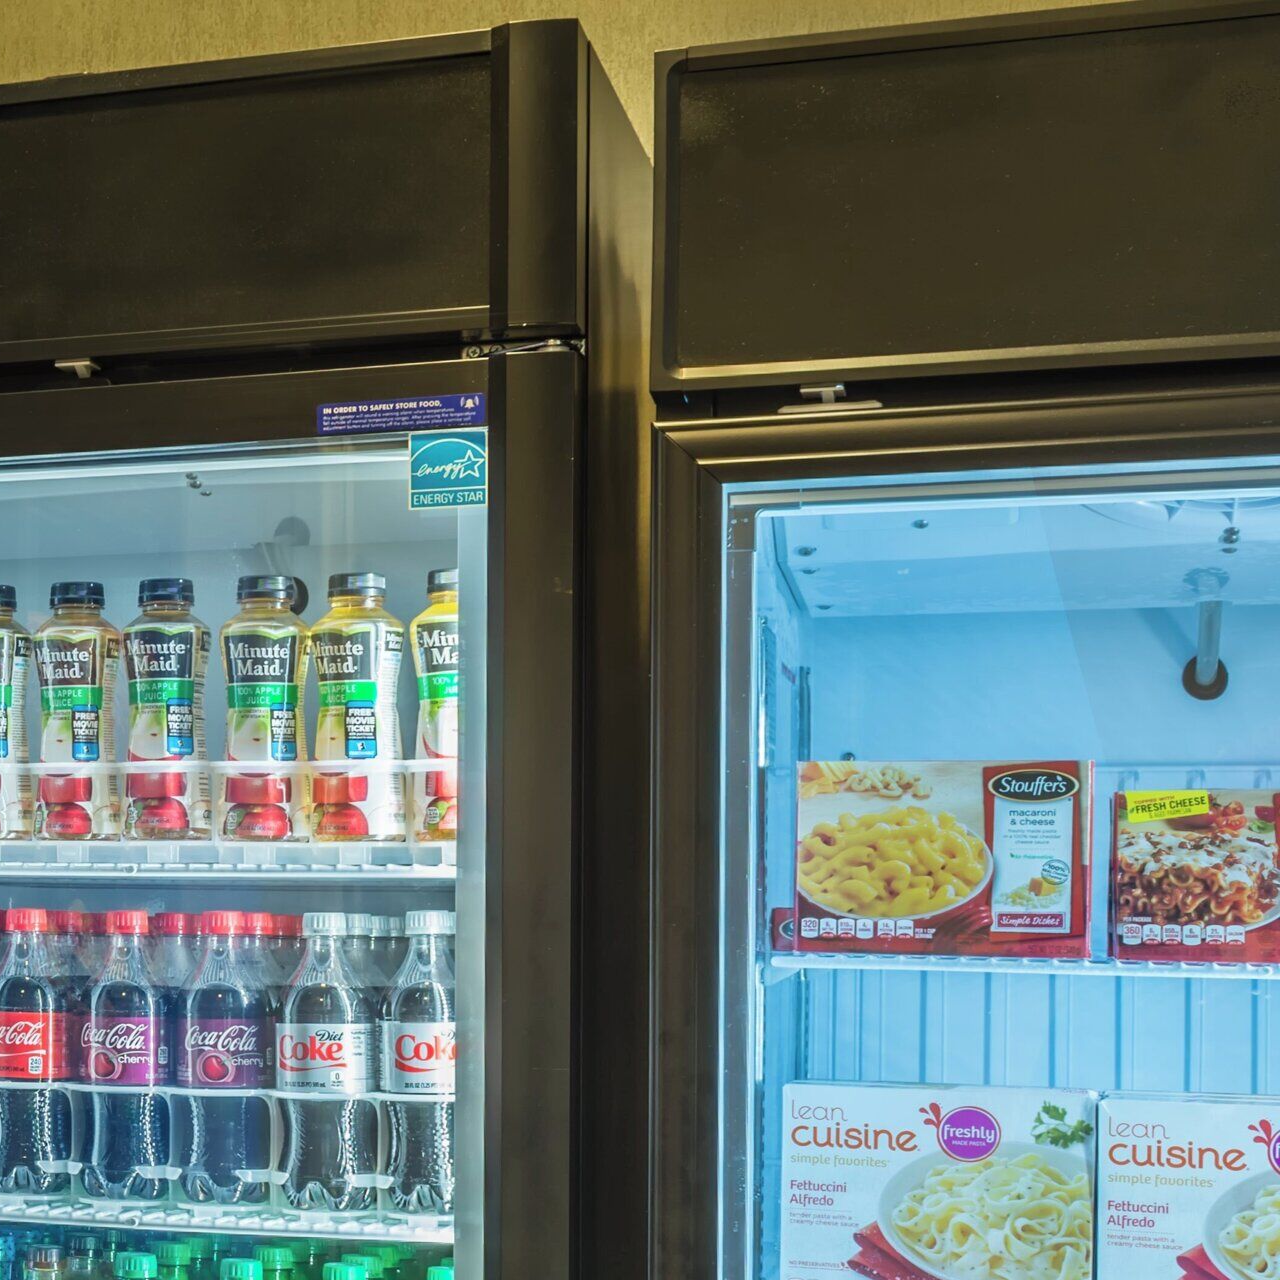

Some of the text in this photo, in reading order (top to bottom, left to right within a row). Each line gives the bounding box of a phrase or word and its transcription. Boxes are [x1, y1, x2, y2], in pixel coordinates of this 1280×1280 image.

[333, 406, 357, 414] ORDER
[370, 403, 394, 412] SAFELY
[395, 401, 417, 410] STORE
[413, 492, 483, 505] ENERGY STAR
[229, 642, 289, 659] Minute
[135, 655, 178, 672] Maid
[237, 659, 281, 676] Maid
[152, 682, 179, 691] APPLE
[258, 685, 282, 695] APPLE
[245, 695, 270, 704] JUICE
[349, 708, 372, 717] FREE
[346, 716, 375, 725] MOVIE
[346, 724, 375, 733] TICKET
[998, 775, 1067, 795] Stouffer's
[1136, 796, 1206, 814] FRESH CHEESE
[1009, 809, 1056, 817] macaroni
[1019, 817, 1055, 826] cheese
[1047, 863, 1066, 873] 100%
[803, 920, 817, 928] 320
[998, 913, 1061, 926] Simple Dishes
[1124, 926, 1140, 935] 360
[185, 1025, 259, 1052] Coca-Cola
[315, 1029, 344, 1042] Diet
[279, 1034, 345, 1062] Coke
[118, 1054, 154, 1067] cherry
[231, 1056, 264, 1068] cherry
[791, 1099, 848, 1121] lean
[943, 1124, 995, 1143] freshly
[1108, 1116, 1170, 1139] lean
[791, 1122, 918, 1152] cuisine
[791, 1153, 887, 1168] simple favorites
[1108, 1140, 1248, 1172] cuisine
[790, 1180, 847, 1193] Fettuccini
[1108, 1172, 1213, 1188] simple favorites
[790, 1194, 834, 1207] Alfredo
[1107, 1200, 1169, 1214] Fettuccini
[1107, 1214, 1155, 1229] Alfredo
